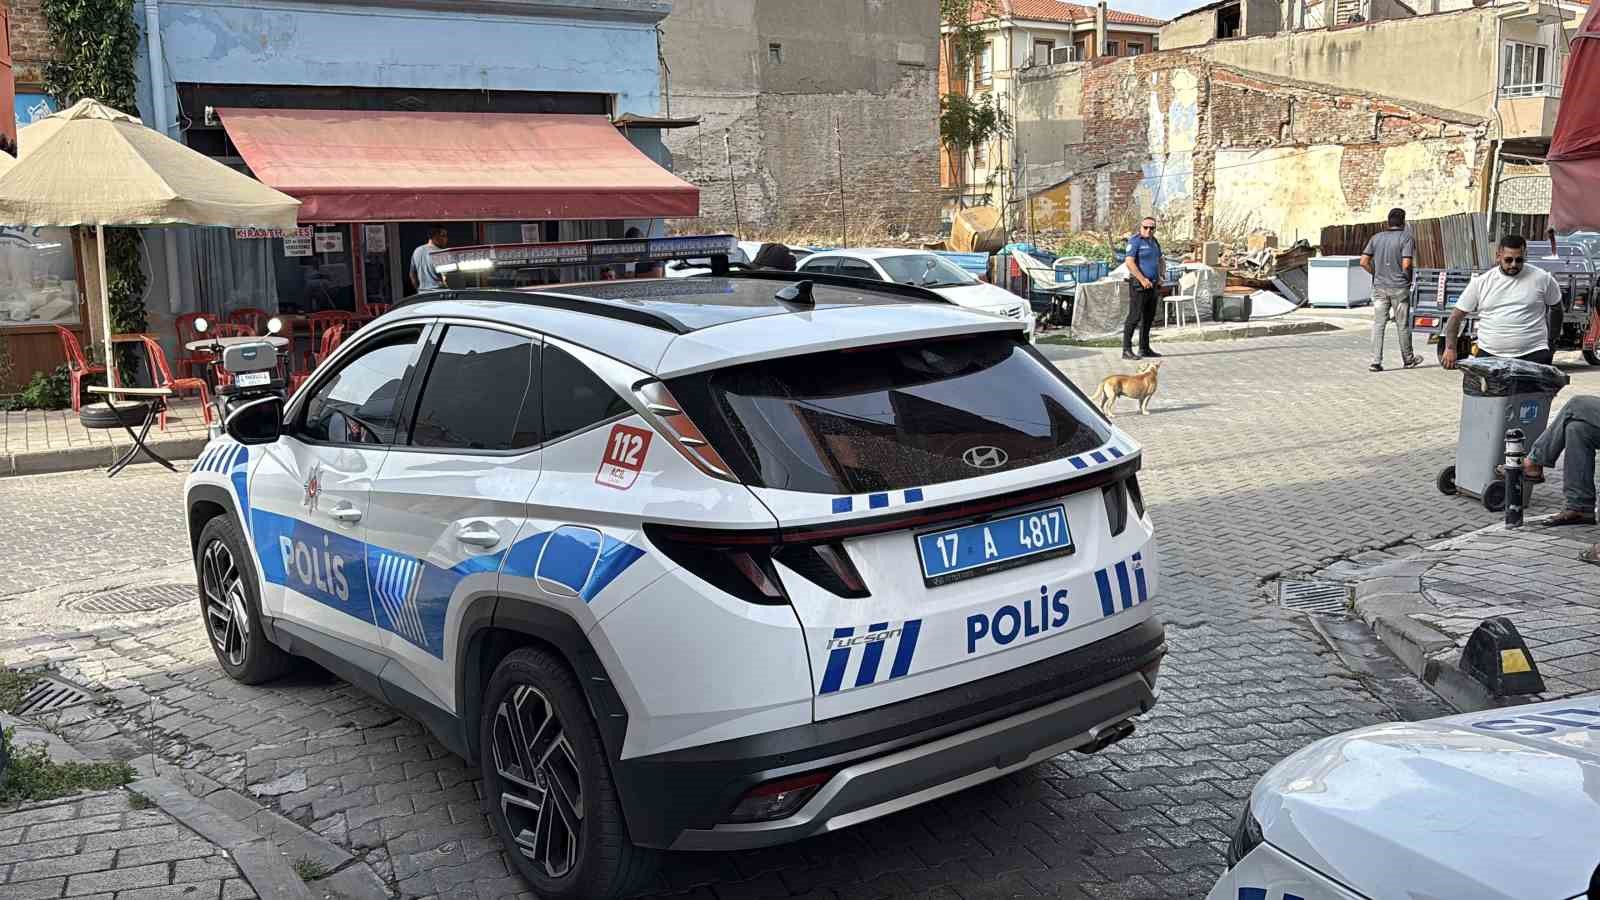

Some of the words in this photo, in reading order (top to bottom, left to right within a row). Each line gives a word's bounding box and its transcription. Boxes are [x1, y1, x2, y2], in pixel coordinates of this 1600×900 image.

[611, 431, 643, 466] 112
[279, 534, 349, 601] POLİS
[936, 532, 960, 568] 17
[983, 527, 998, 559] A
[1019, 511, 1060, 549] 4817
[966, 585, 1070, 654] POLİS
